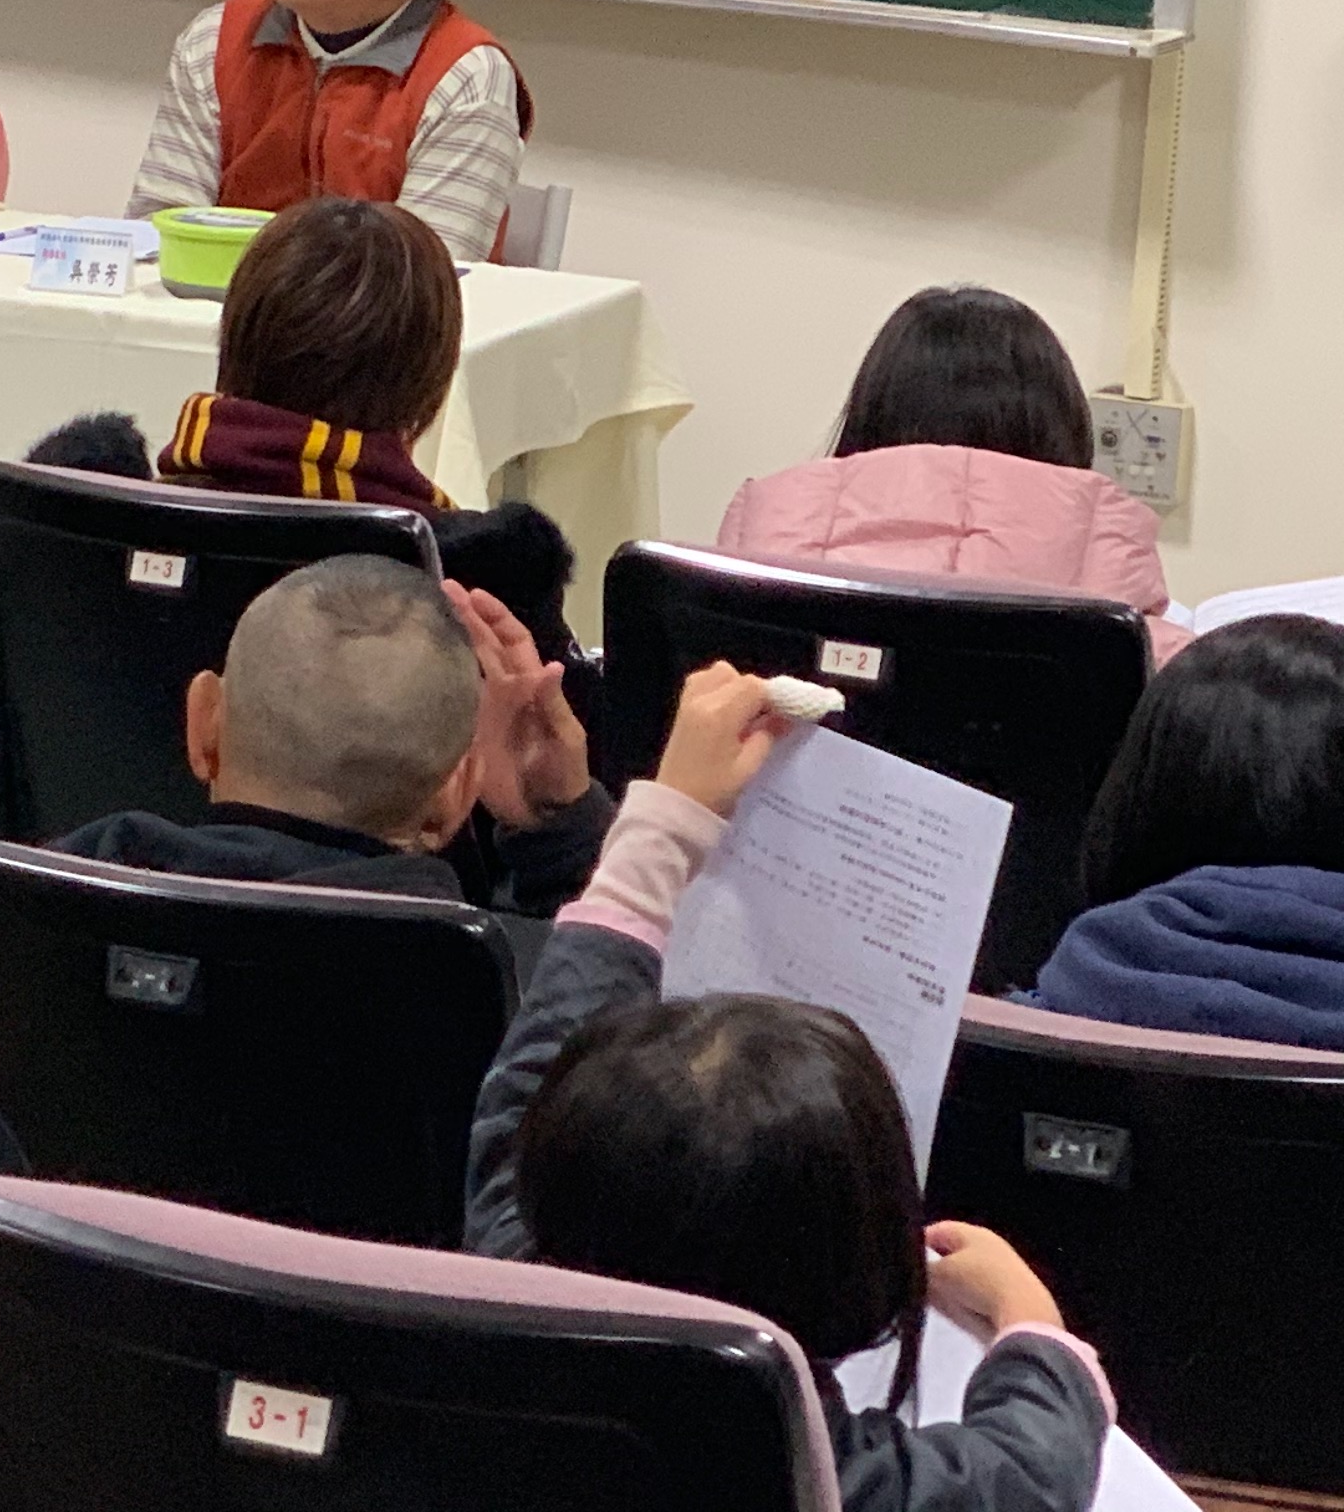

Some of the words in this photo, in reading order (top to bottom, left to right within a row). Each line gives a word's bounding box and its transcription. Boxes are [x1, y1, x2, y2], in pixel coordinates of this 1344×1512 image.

[143, 558, 173, 579] 1-3
[834, 649, 868, 670] 1-2
[249, 1395, 309, 1439] 3-1
